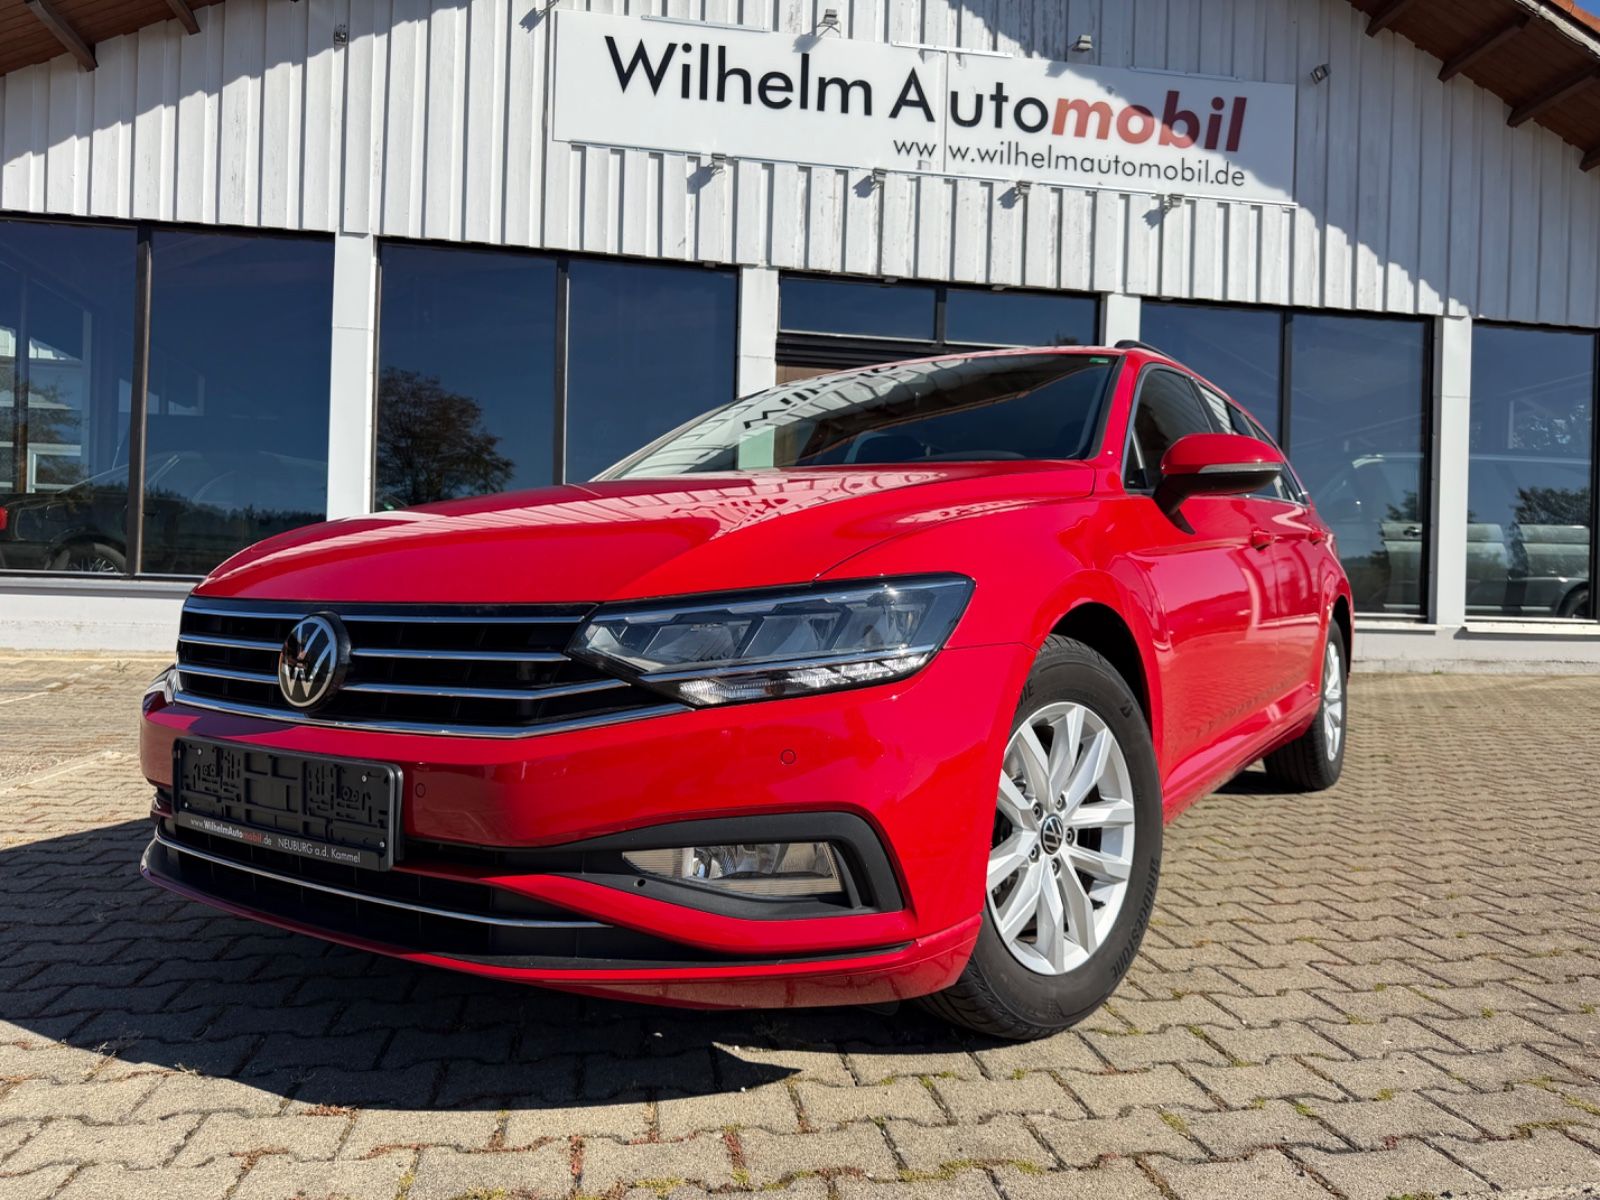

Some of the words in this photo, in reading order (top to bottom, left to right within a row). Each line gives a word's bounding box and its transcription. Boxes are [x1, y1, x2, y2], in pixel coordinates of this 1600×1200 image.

[605, 36, 872, 115] Wilhelm
[278, 615, 337, 707] VW
[278, 838, 313, 854] NEUBURG
